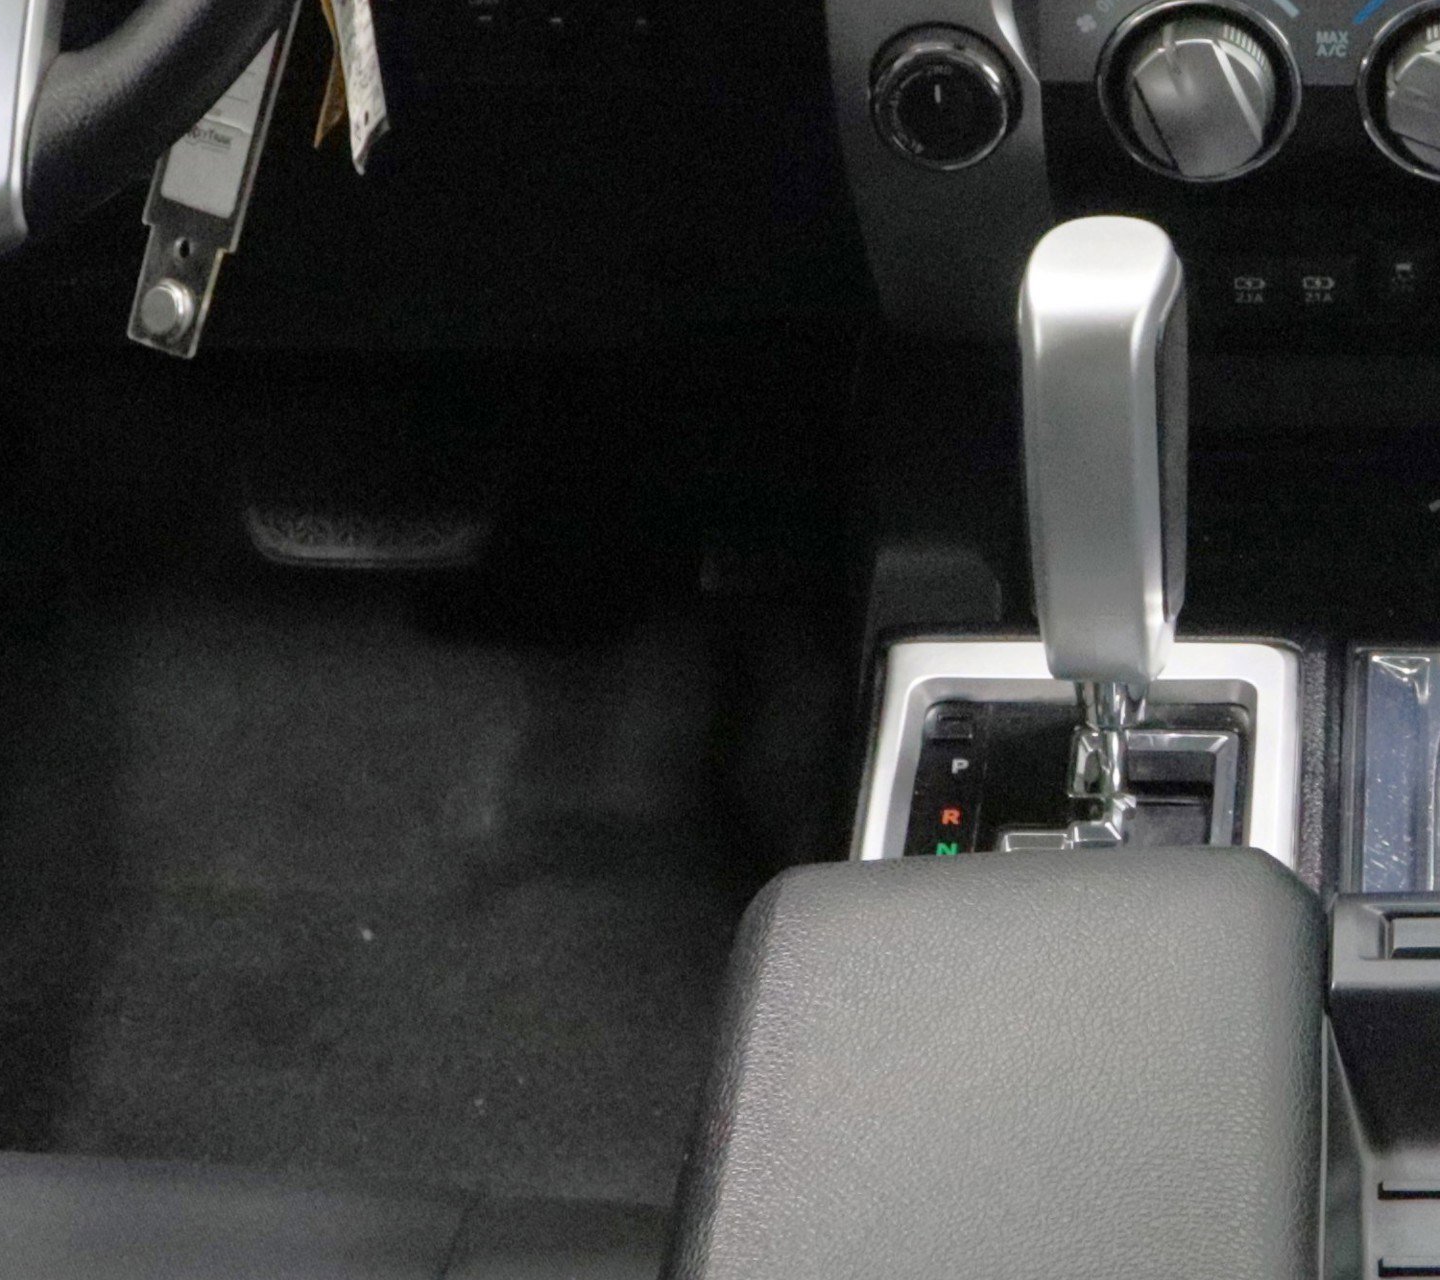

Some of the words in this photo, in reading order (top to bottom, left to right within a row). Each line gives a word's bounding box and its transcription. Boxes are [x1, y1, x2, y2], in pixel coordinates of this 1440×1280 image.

[1316, 30, 1349, 44] MAX
[1316, 44, 1348, 58] A/C
[952, 759, 969, 774] P
[942, 808, 960, 824] R
[936, 841, 958, 856] N
